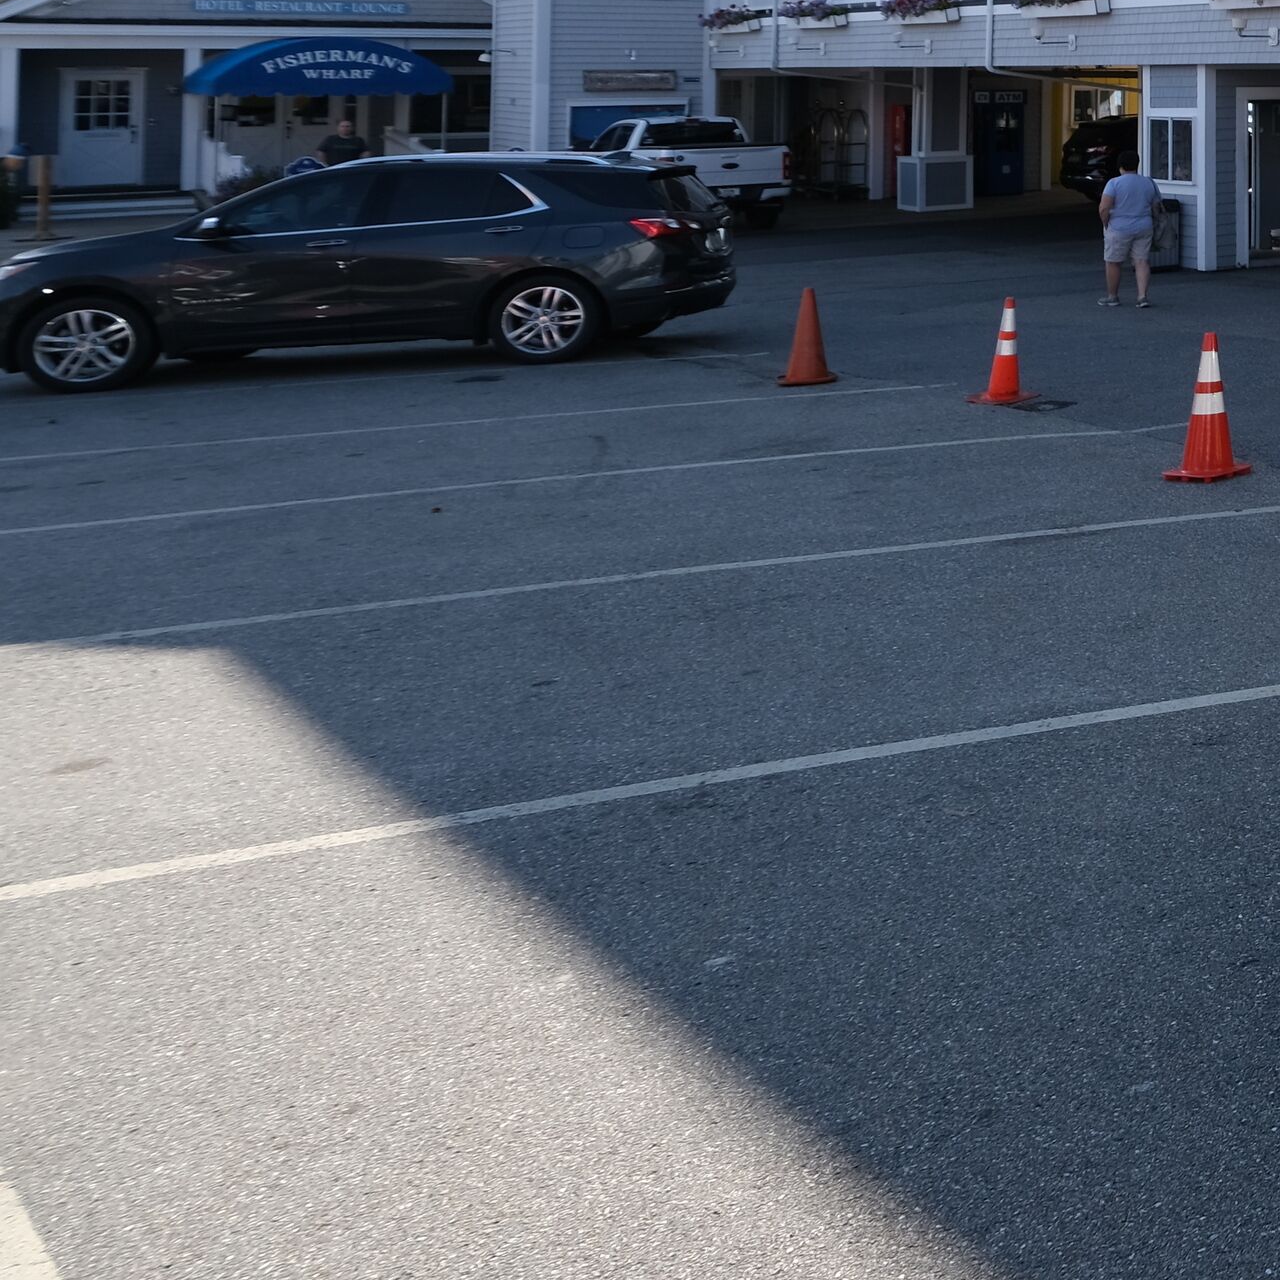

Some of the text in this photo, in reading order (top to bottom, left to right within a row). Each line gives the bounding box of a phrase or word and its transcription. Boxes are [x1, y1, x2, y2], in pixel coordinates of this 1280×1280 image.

[194, 0, 406, 14] HOTEL RESTAURANT LOUNGE
[260, 49, 414, 74] FISHERMAN'S
[302, 69, 375, 80] WHARF
[997, 92, 1022, 102] ATM
